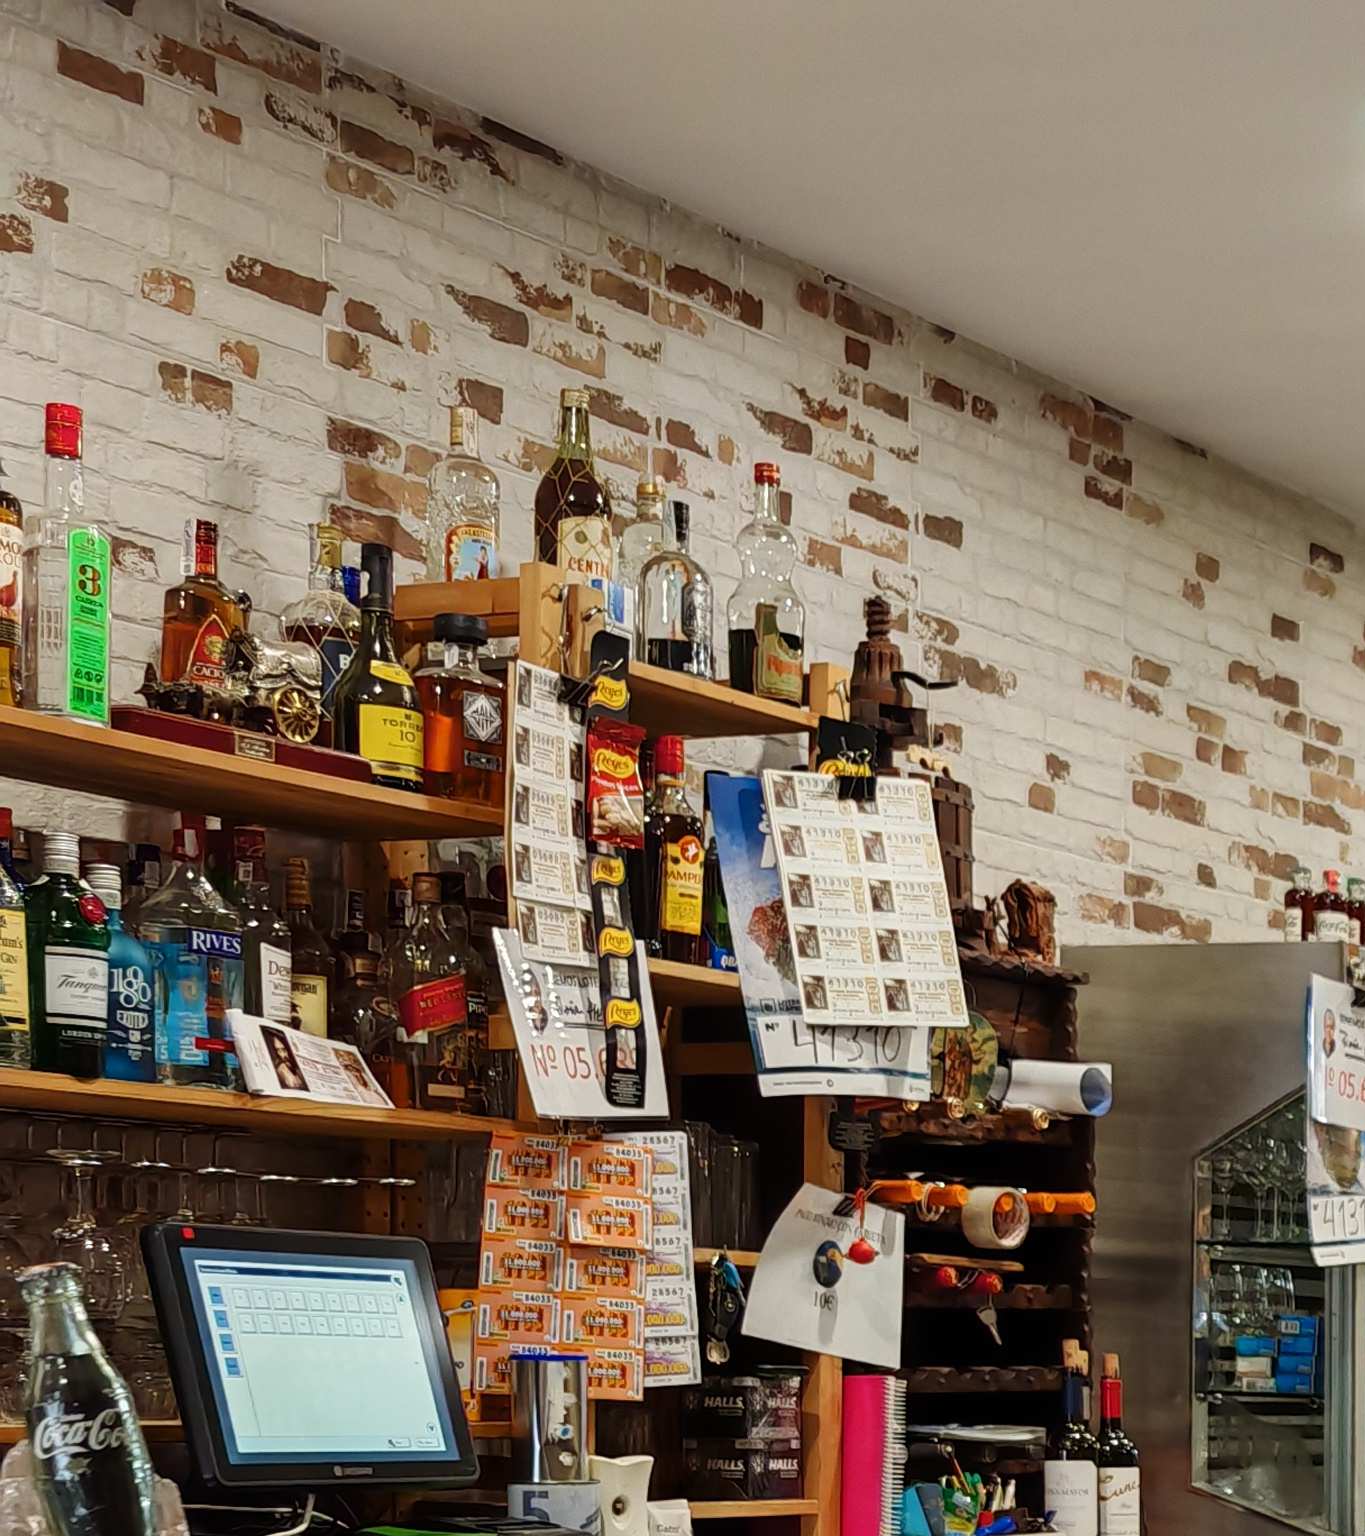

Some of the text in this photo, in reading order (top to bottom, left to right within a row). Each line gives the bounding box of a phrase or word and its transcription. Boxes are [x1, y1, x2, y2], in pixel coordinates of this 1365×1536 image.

[400, 731, 416, 743] 10
[192, 931, 241, 954] RIVES
[704, 1396, 744, 1408] HALLS
[768, 1458, 798, 1470] HALLS
